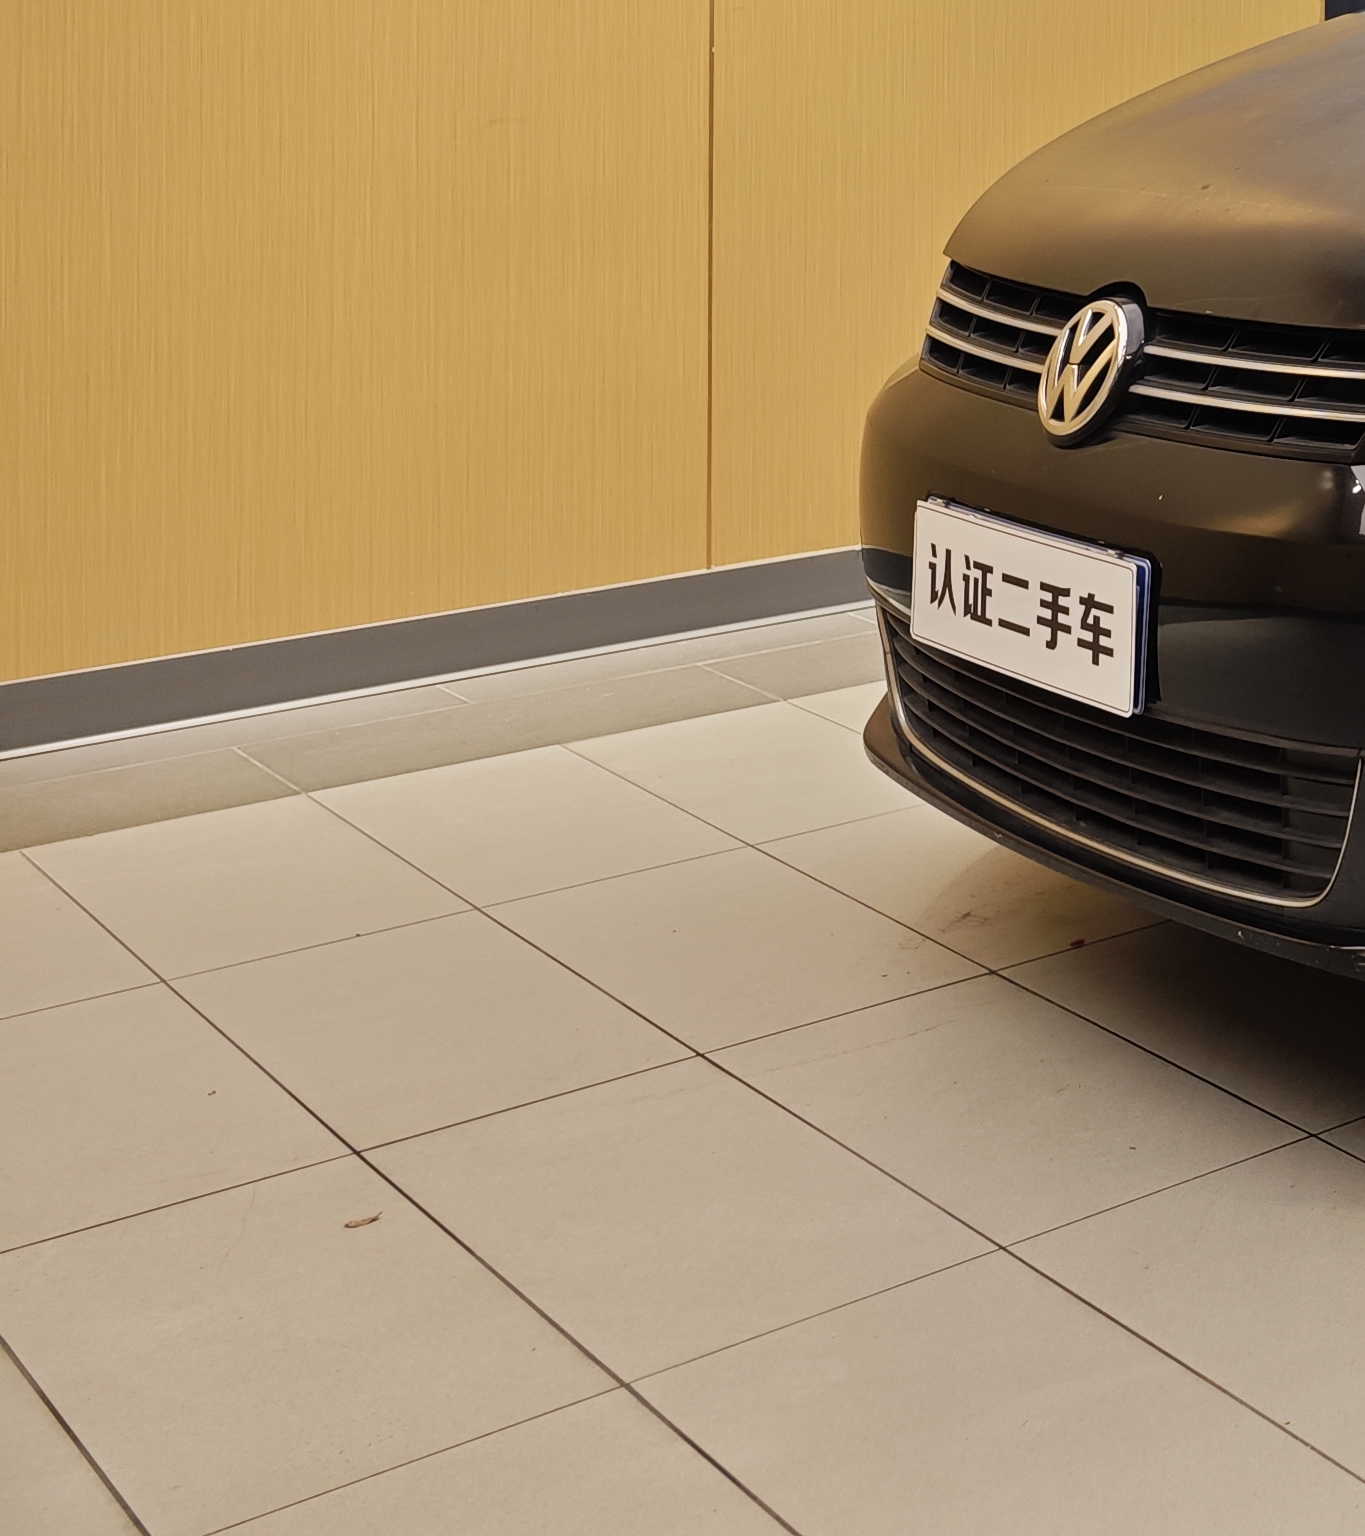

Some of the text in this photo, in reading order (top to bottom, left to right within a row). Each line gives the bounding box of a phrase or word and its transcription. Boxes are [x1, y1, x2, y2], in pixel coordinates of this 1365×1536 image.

[929, 542, 1114, 667] 认证二手车
